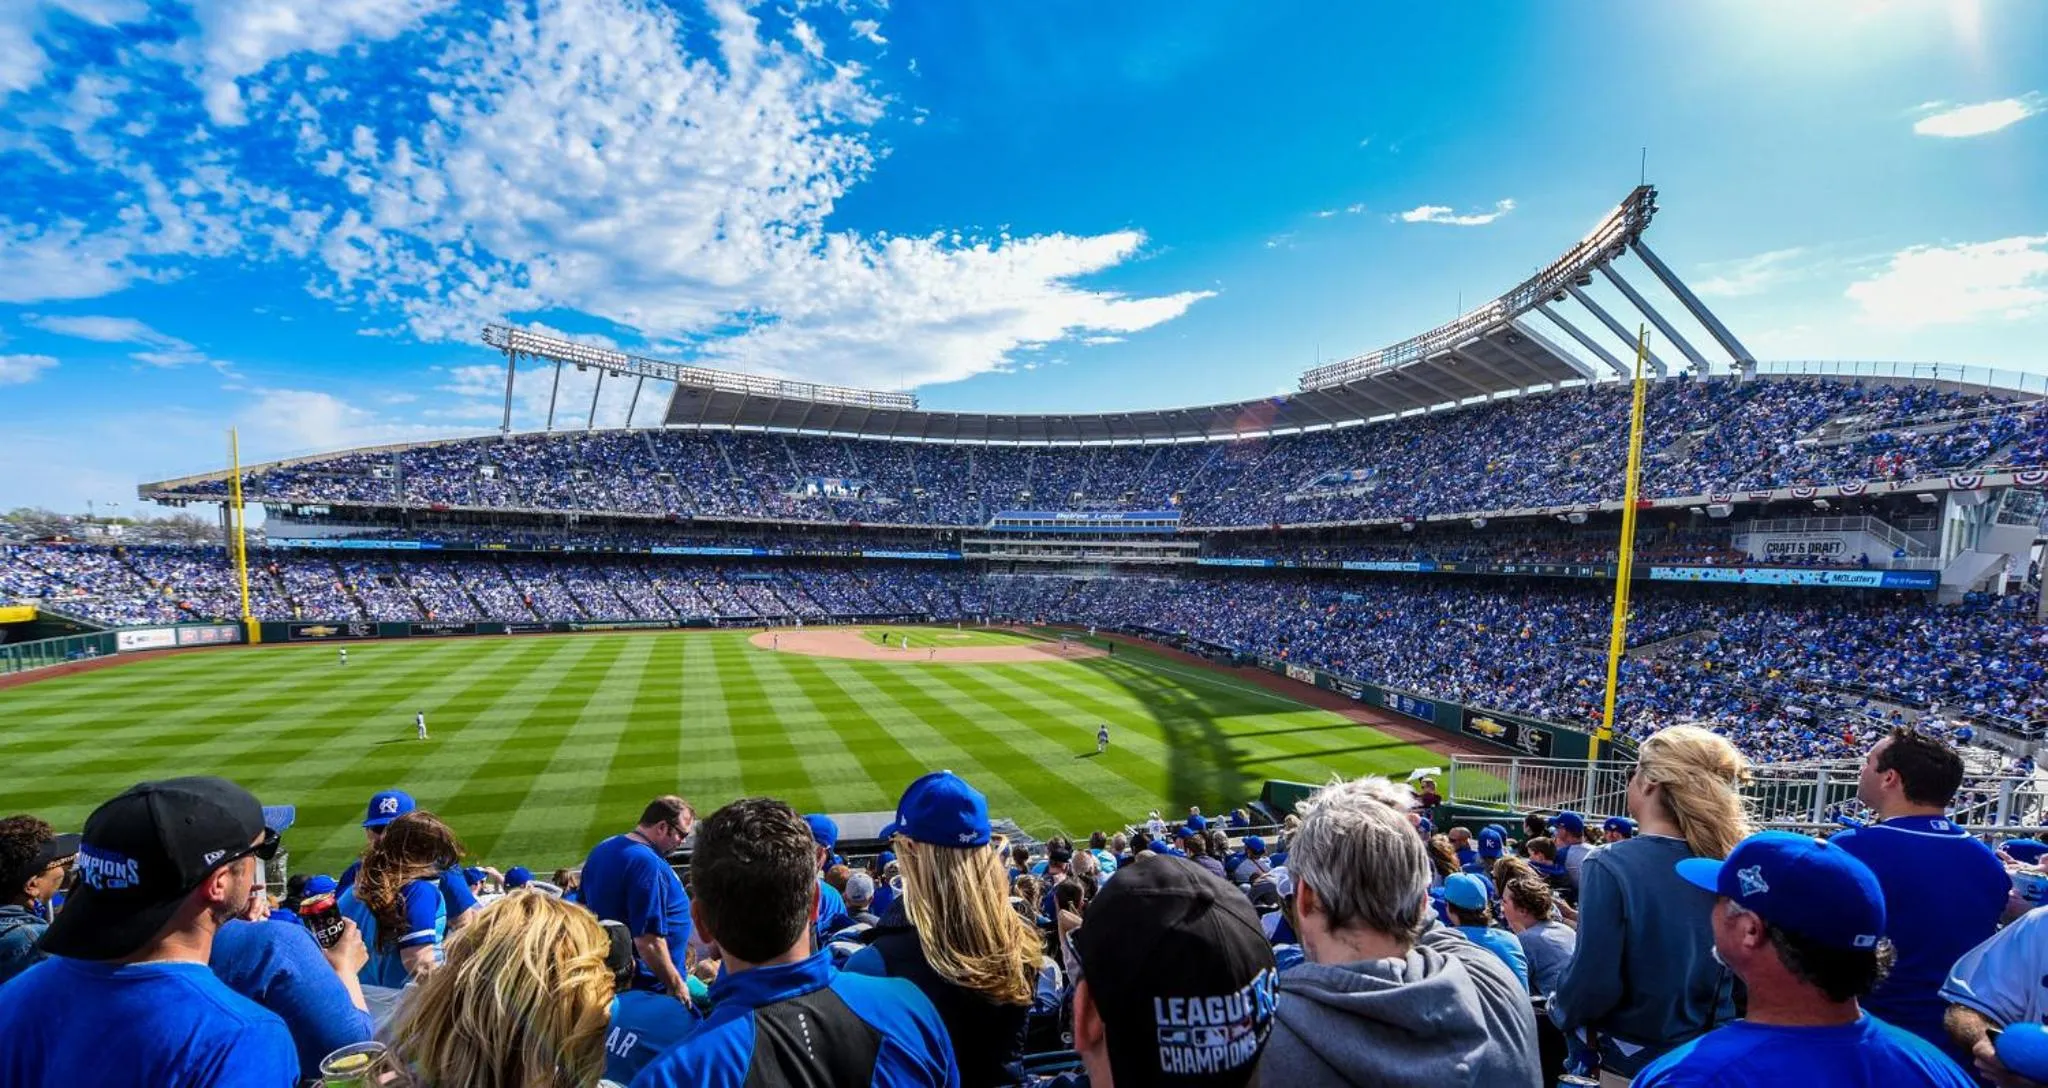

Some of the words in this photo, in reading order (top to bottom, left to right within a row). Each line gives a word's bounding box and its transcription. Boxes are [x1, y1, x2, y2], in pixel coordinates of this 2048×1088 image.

[1767, 542, 1796, 554] CRAFT
[1808, 542, 1841, 554] DRAFT
[1153, 984, 1255, 1026] LEAGUE
[1159, 1031, 1258, 1074] CHAMPIONS
